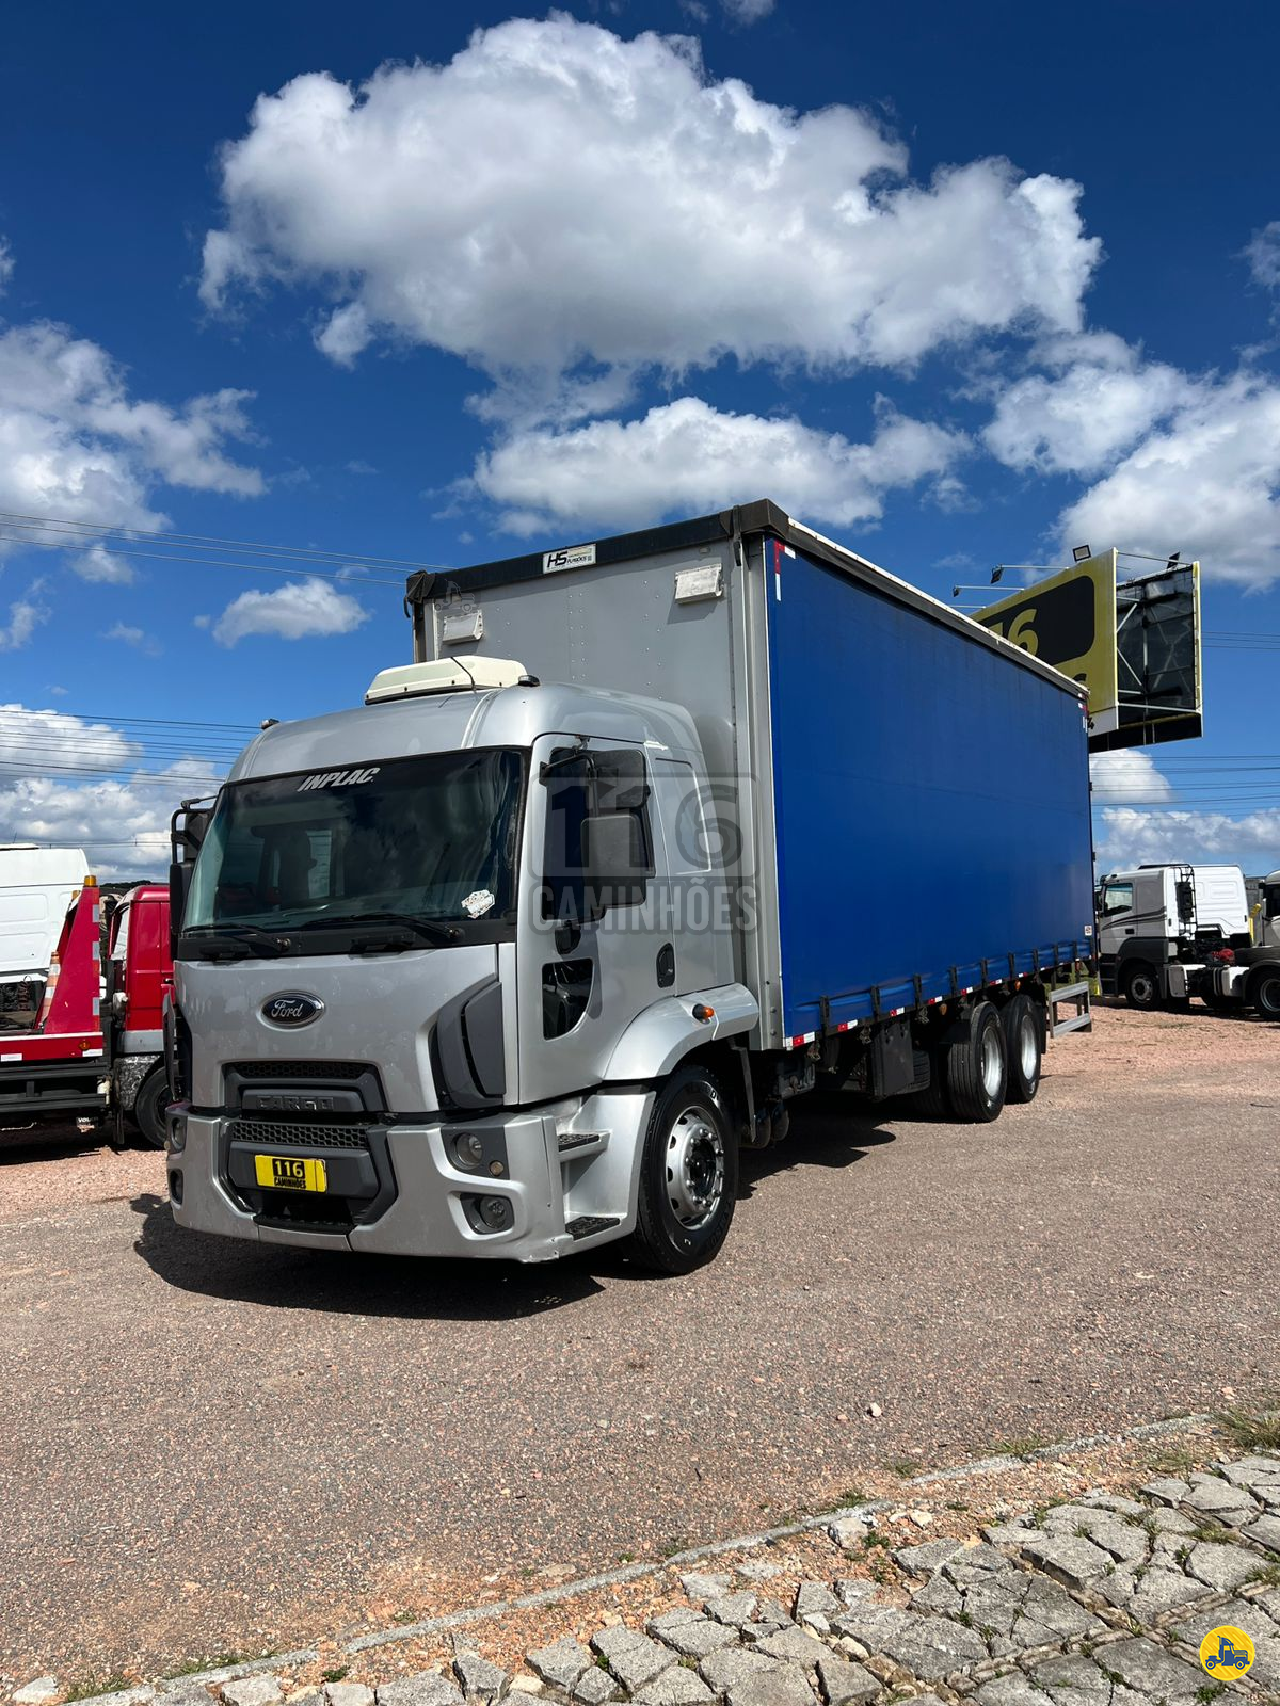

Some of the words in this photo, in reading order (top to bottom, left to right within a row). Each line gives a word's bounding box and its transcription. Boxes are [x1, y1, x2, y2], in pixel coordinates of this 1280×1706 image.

[547, 551, 568, 568] HS
[297, 767, 380, 792] INPLAC
[271, 999, 304, 1018] Ford
[274, 1160, 304, 1178] 116
